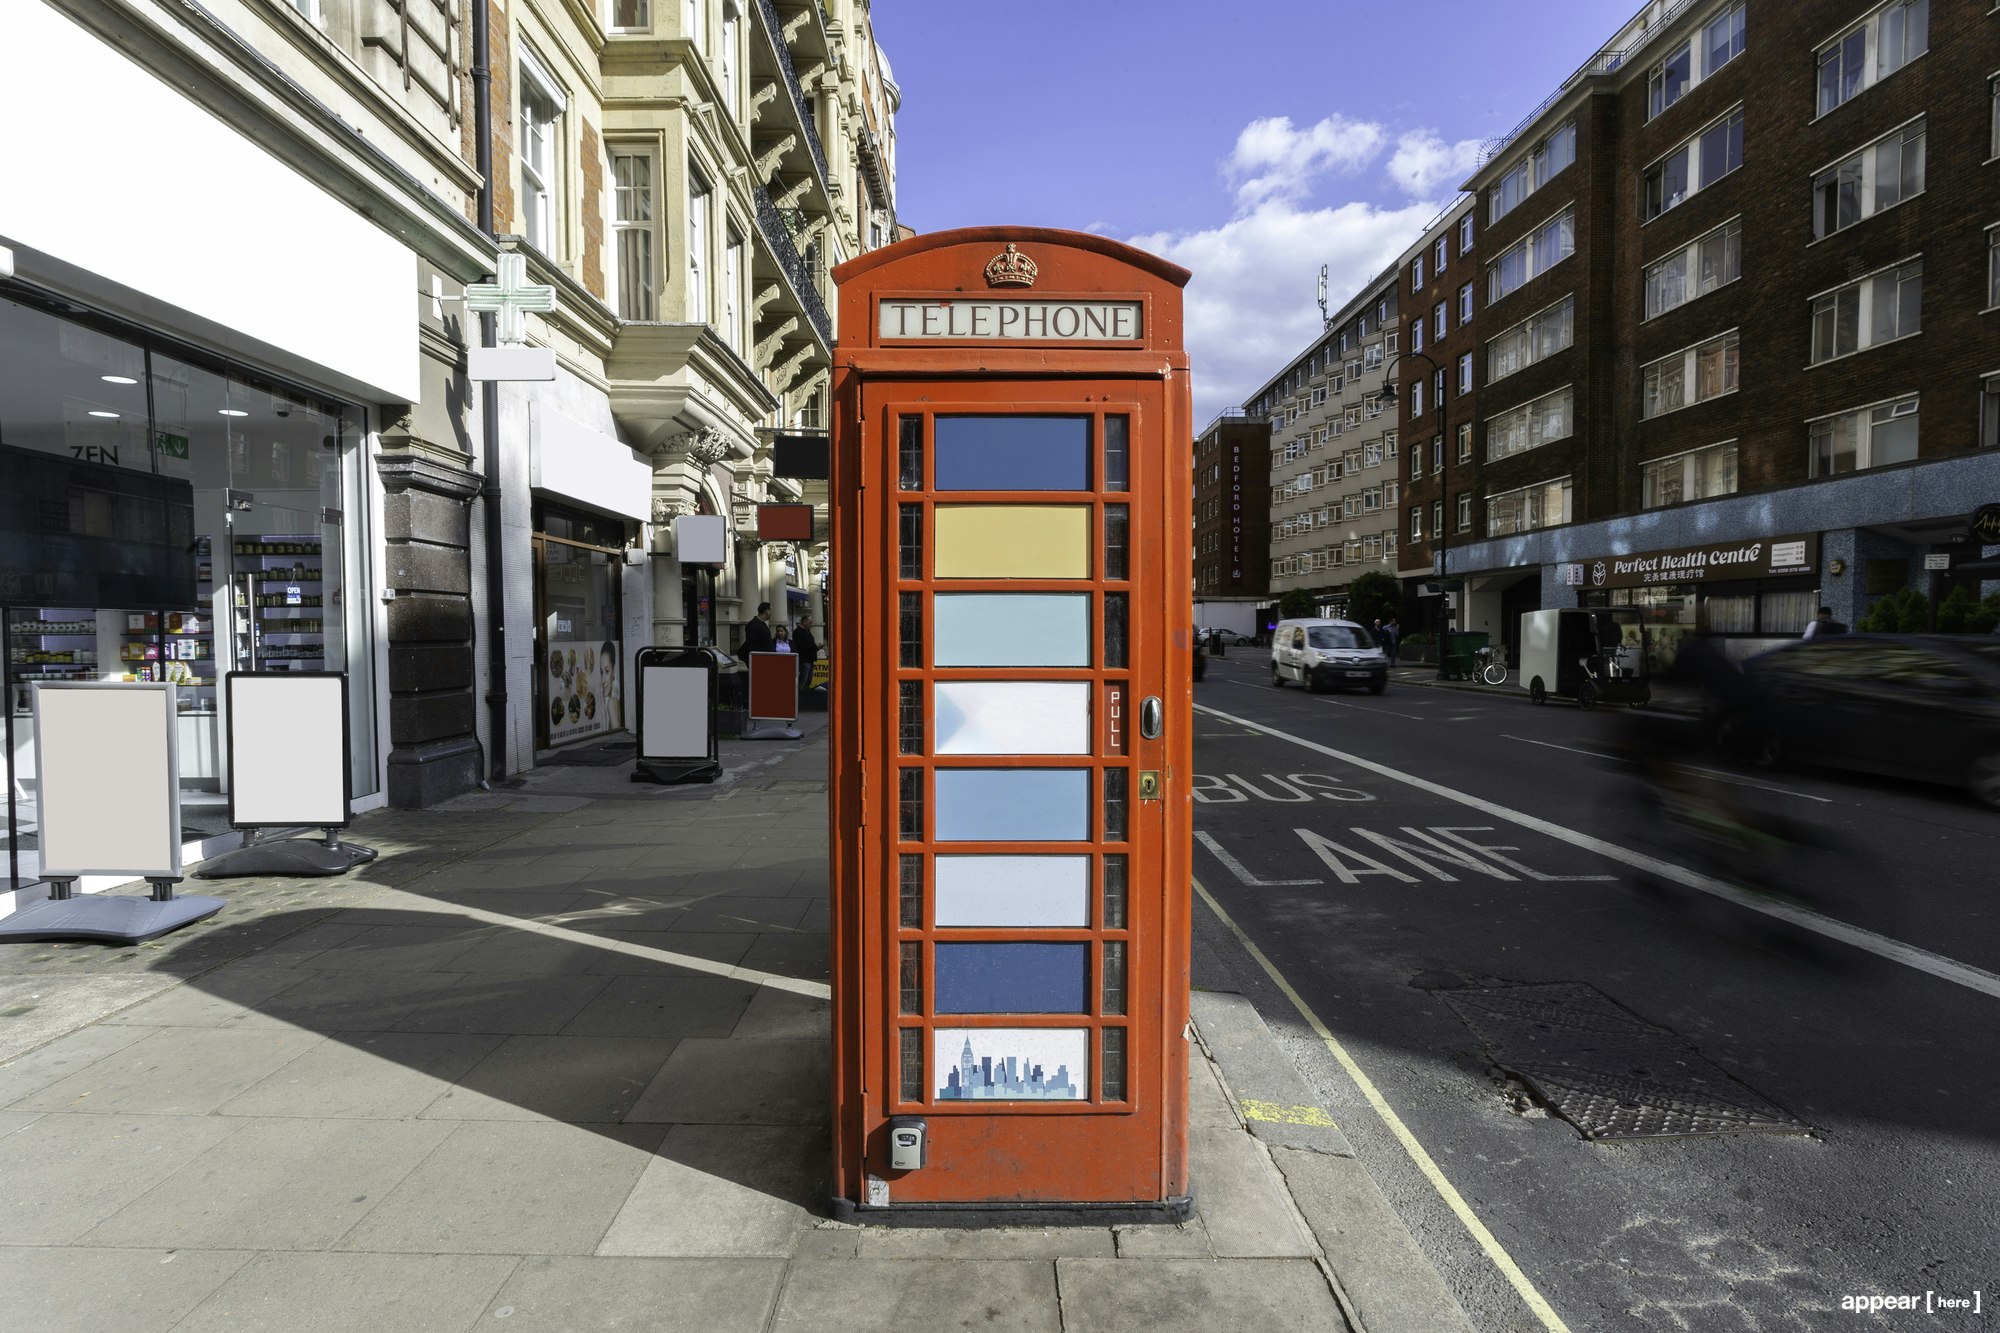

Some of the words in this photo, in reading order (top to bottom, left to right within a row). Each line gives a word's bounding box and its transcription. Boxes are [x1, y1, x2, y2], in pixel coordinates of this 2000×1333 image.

[891, 305, 1132, 338] TELEPHONE
[1614, 556, 1658, 575] Perfect
[1660, 550, 1707, 570] Health
[1709, 542, 1762, 566] Centre
[287, 586, 301, 594] OPEN
[1111, 691, 1120, 747] PULL
[1192, 773, 1377, 803] BUS
[1192, 827, 1621, 887] LANE
